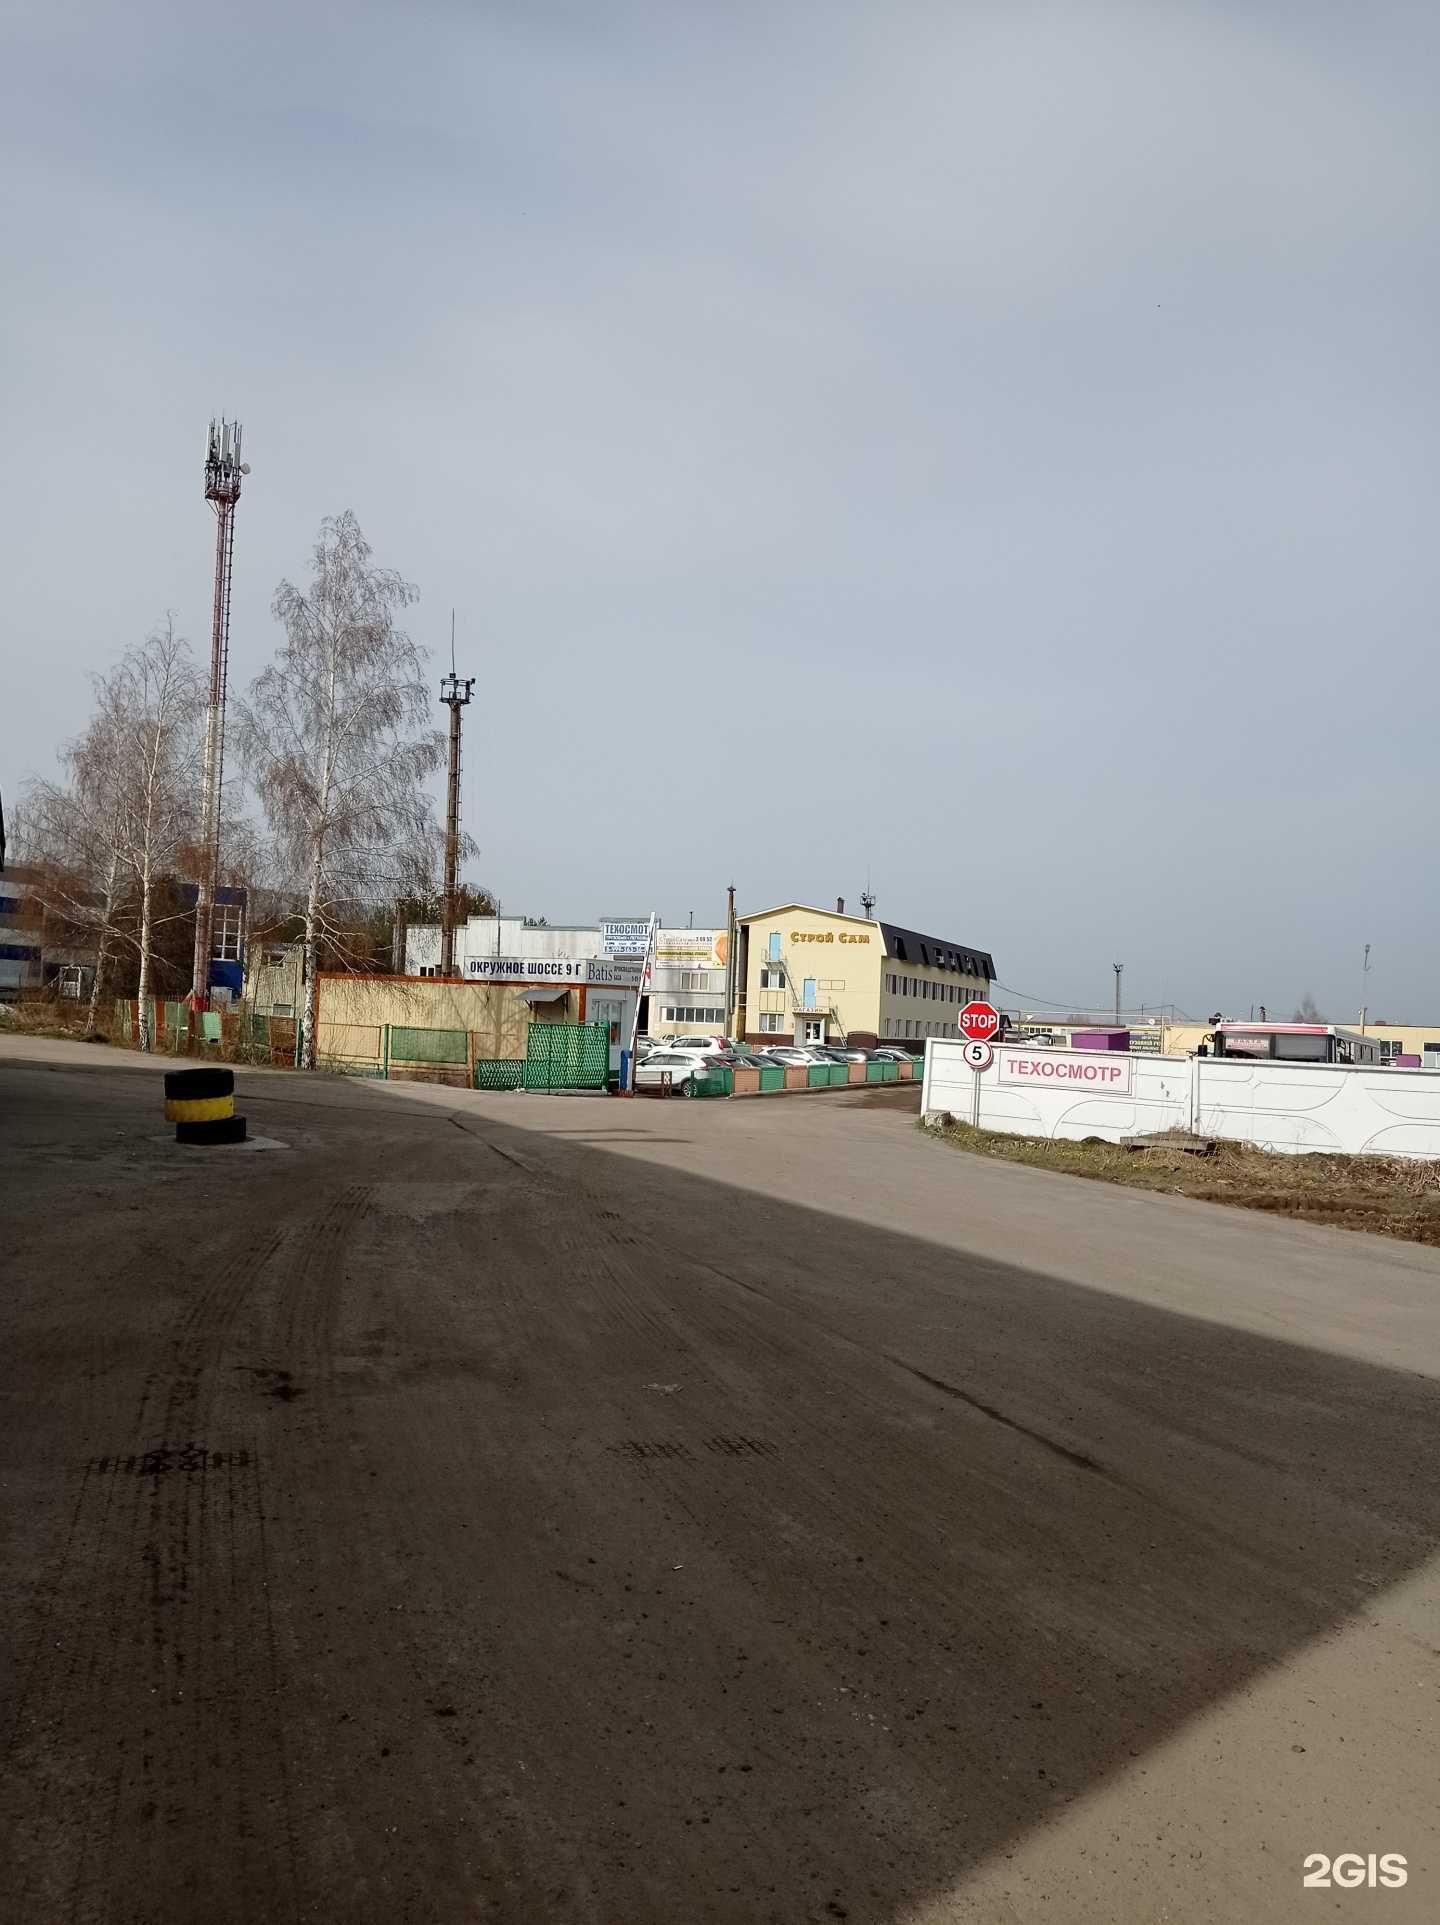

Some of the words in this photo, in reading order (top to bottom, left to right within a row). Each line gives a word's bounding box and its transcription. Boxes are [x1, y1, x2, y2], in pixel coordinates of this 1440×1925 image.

[604, 924, 649, 934] ТЕХОСМОТ
[470, 961, 525, 975] ОКРУЖНОЕ
[527, 962, 563, 975] ШОССЕ
[565, 963, 572, 975] 9
[575, 963, 582, 976] Г
[588, 962, 613, 981] Batis
[962, 1013, 997, 1029] STOP
[972, 1046, 982, 1061] 5
[1007, 1059, 1122, 1082] ТЕХОСМОТР
